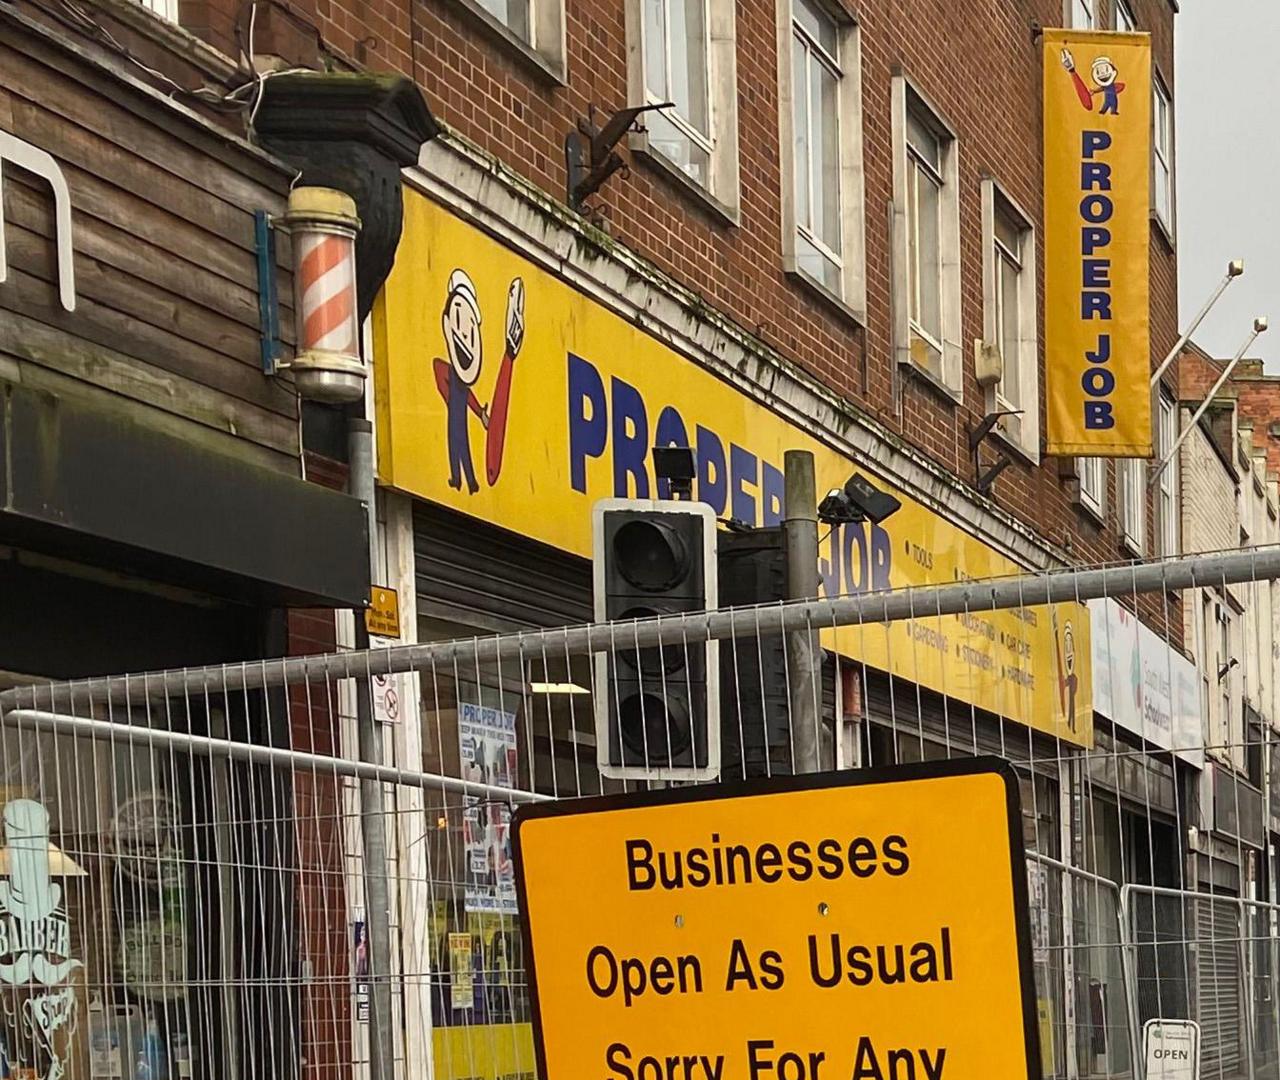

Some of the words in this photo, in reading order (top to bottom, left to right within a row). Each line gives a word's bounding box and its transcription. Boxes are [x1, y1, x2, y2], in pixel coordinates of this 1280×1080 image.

[1080, 130, 1114, 320] PROPER
[1081, 334, 1116, 431] JOB
[913, 544, 933, 570] TOOLS
[625, 833, 911, 891] Businesses
[586, 945, 703, 1006] Open
[725, 938, 785, 992] As
[808, 927, 953, 988] Usual
[1153, 1049, 1188, 1060] OPEN
